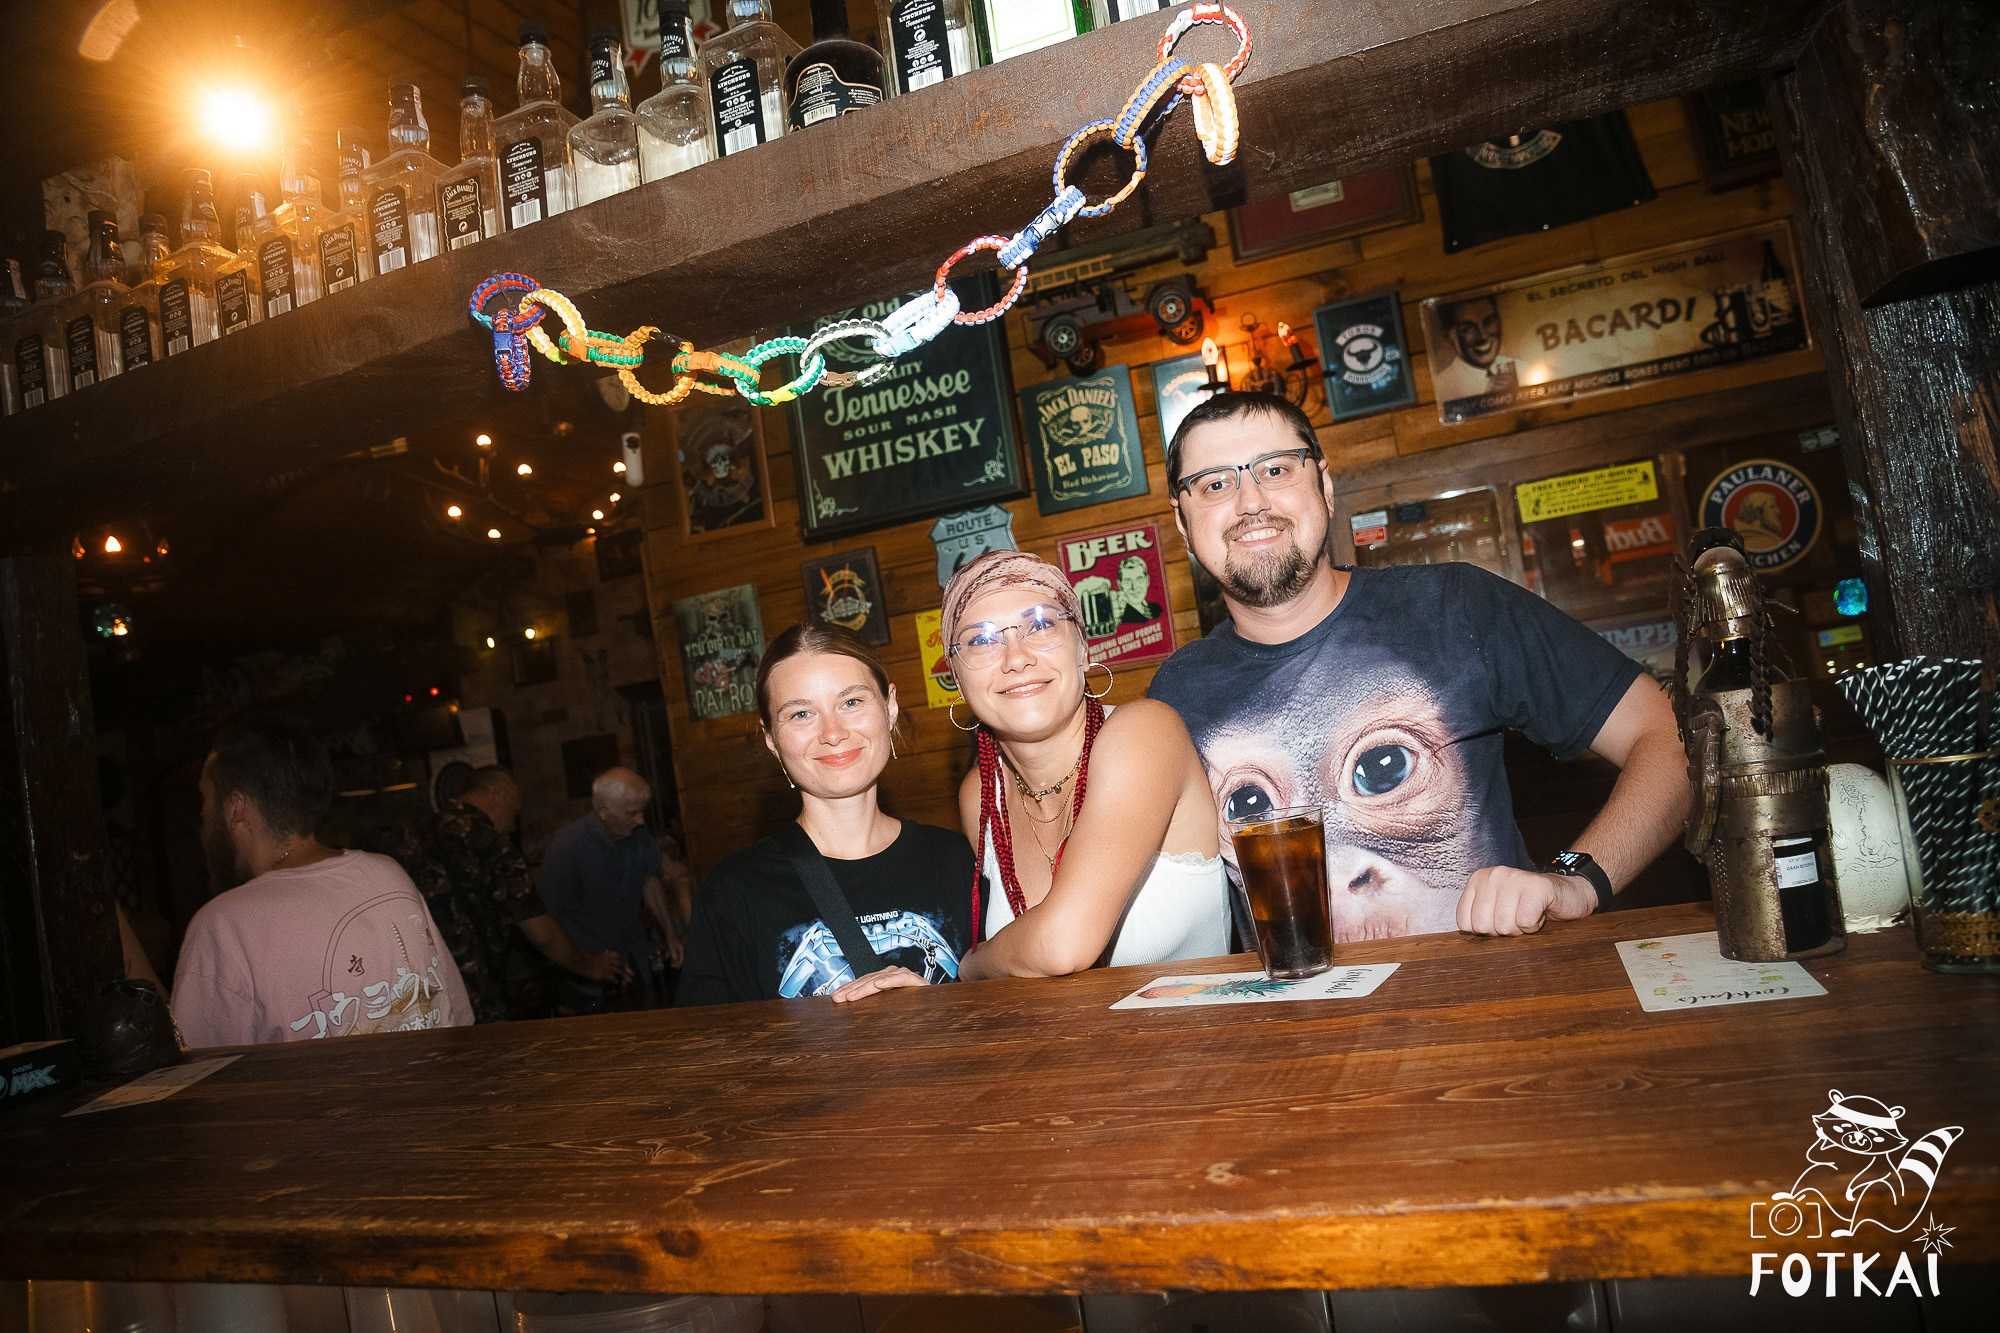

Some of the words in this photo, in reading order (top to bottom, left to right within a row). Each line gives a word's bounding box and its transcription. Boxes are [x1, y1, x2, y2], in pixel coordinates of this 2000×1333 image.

[899, 5, 936, 22] LYNCHBURG
[717, 72, 751, 89] LYNCHBURG
[506, 149, 537, 164] LYNCHBURG
[1527, 291, 1544, 303] EL
[1550, 276, 1614, 297] SECRETO
[1621, 269, 1648, 284] DEL
[1653, 262, 1687, 277] HIGH
[1694, 251, 1728, 268] BALL
[862, 297, 901, 319] Old
[1536, 296, 1696, 352] BACARDI
[823, 369, 971, 426] Tennessee
[1038, 394, 1070, 424] JACK
[1067, 388, 1118, 409] DANIEL'S
[843, 421, 893, 441] SOUR
[906, 405, 958, 426] MASH
[822, 417, 985, 480] WHISKEY
[1054, 453, 1077, 477] EL
[1081, 443, 1120, 469] PASO
[1710, 466, 1811, 505] PAULANER
[945, 513, 994, 536] ROUTE
[1065, 529, 1153, 573] BEER
[1752, 539, 1802, 567] CHEN
[694, 687, 725, 717] RAT
[729, 680, 758, 711] RO
[860, 910, 899, 924] LIGHTNING
[1674, 985, 1790, 1004] Cocktails
[10, 1064, 57, 1097] MAX
